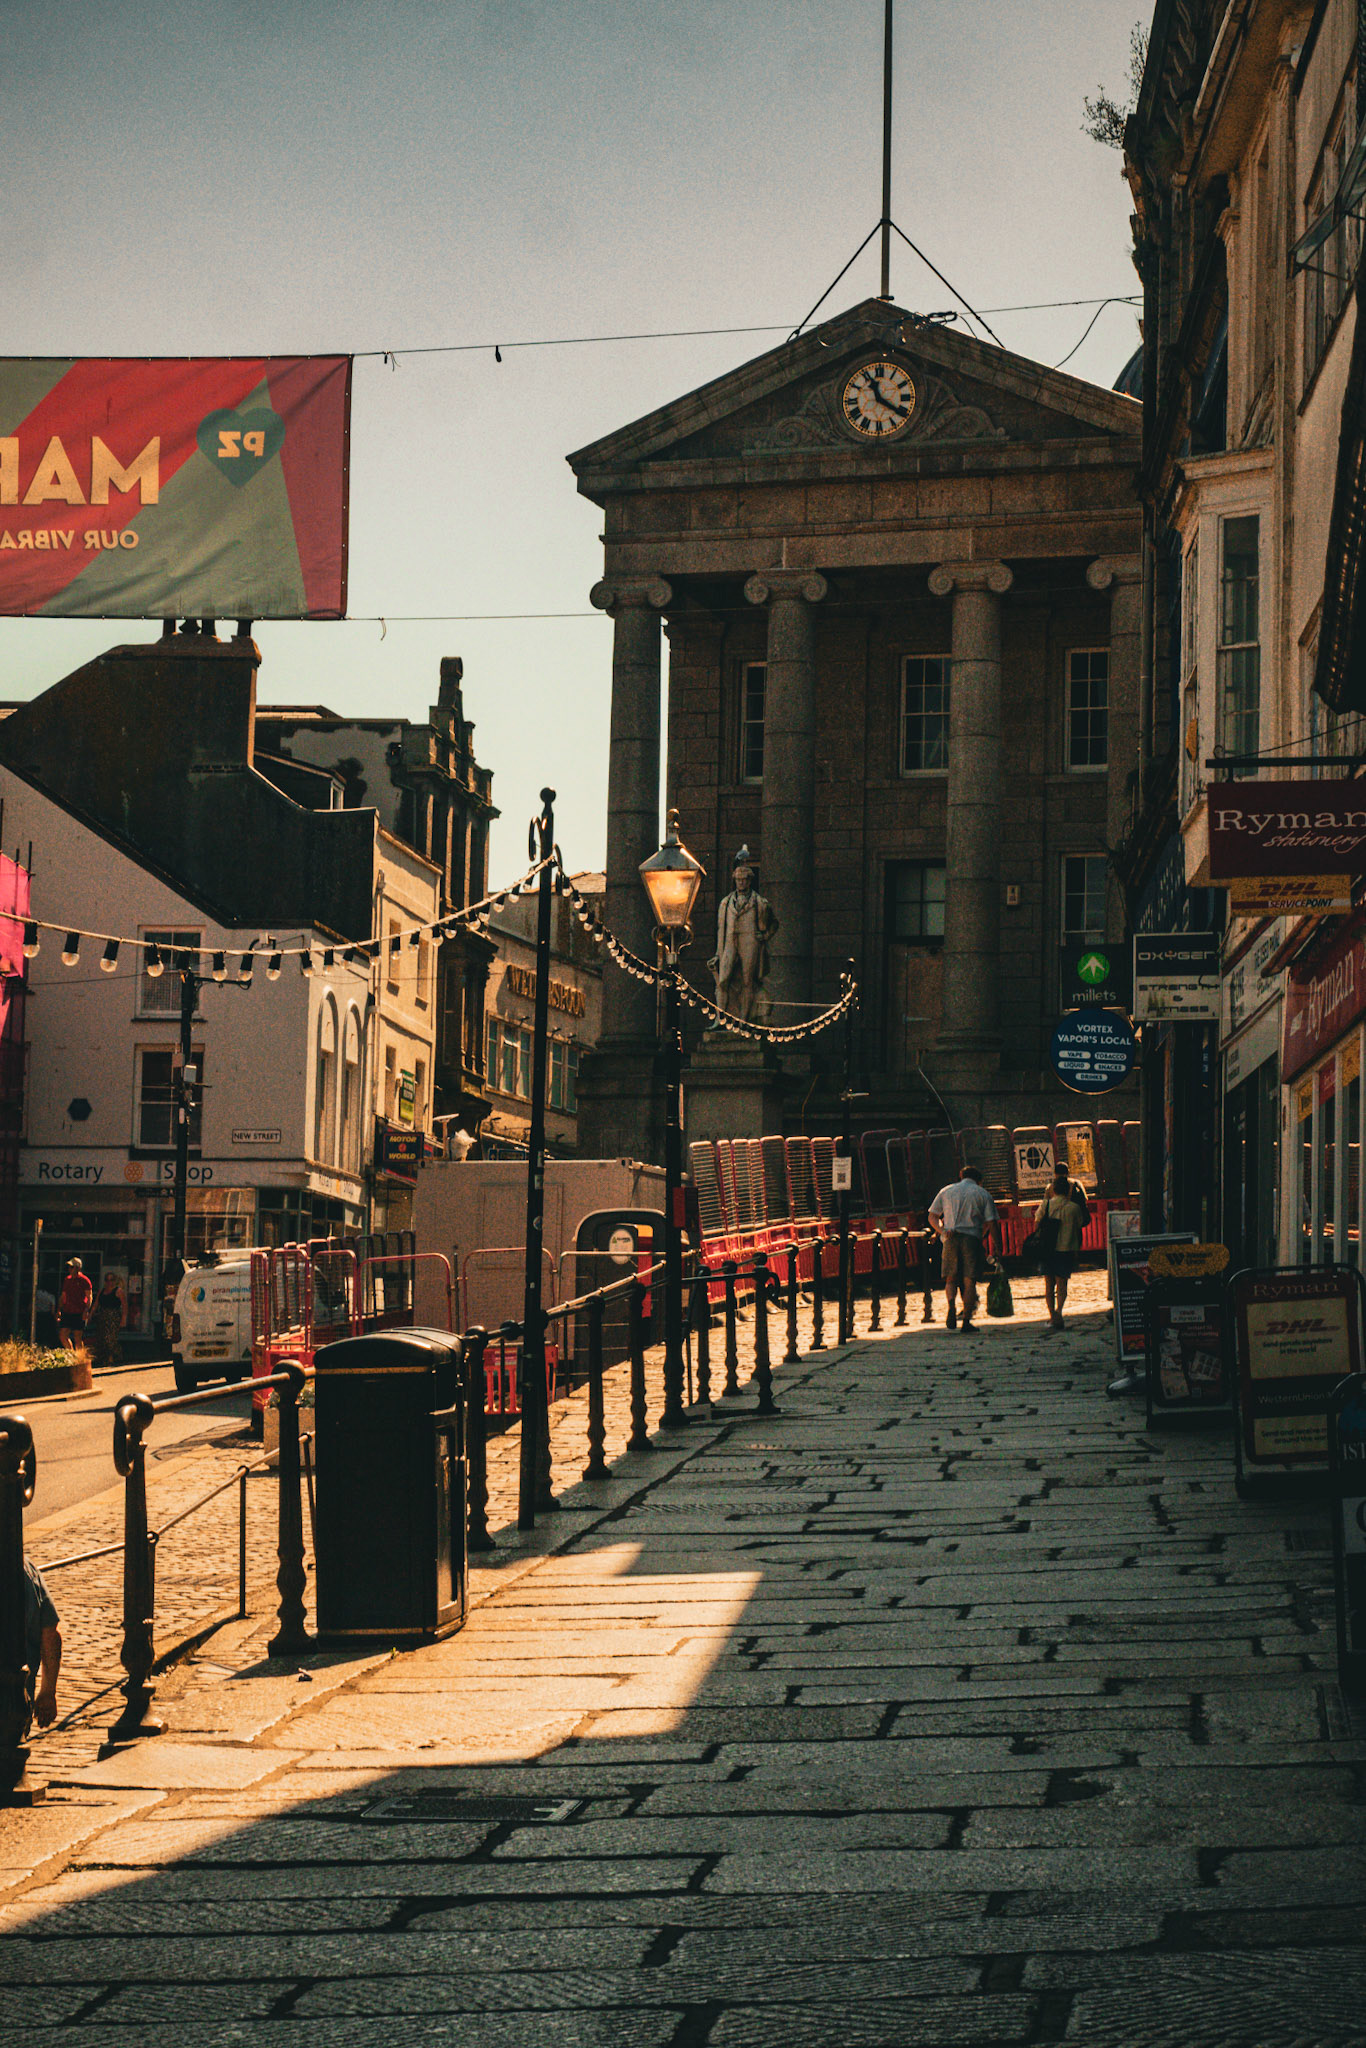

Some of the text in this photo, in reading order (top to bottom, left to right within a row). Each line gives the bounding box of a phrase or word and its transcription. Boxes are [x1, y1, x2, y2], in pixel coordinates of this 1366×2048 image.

[1214, 809, 1366, 835] Ryman
[1262, 830, 1366, 854] stationery
[1257, 882, 1322, 897] DHL
[1269, 898, 1334, 908] SERVICEPOINT
[1072, 988, 1117, 1002] millets
[1305, 949, 1355, 1041] Ryman
[1076, 1024, 1113, 1034] VORTEX
[1057, 1034, 1132, 1046] VAPOR'S LOCAL
[234, 1132, 280, 1140] NEW STREET
[389, 1135, 417, 1143] MOTOR
[1018, 1146, 1051, 1170] FOX
[39, 1162, 213, 1184] Rotary Sop
[1252, 1281, 1339, 1298] Ryman
[1265, 1318, 1325, 1336] DHL
[1262, 1429, 1279, 1438] Send
